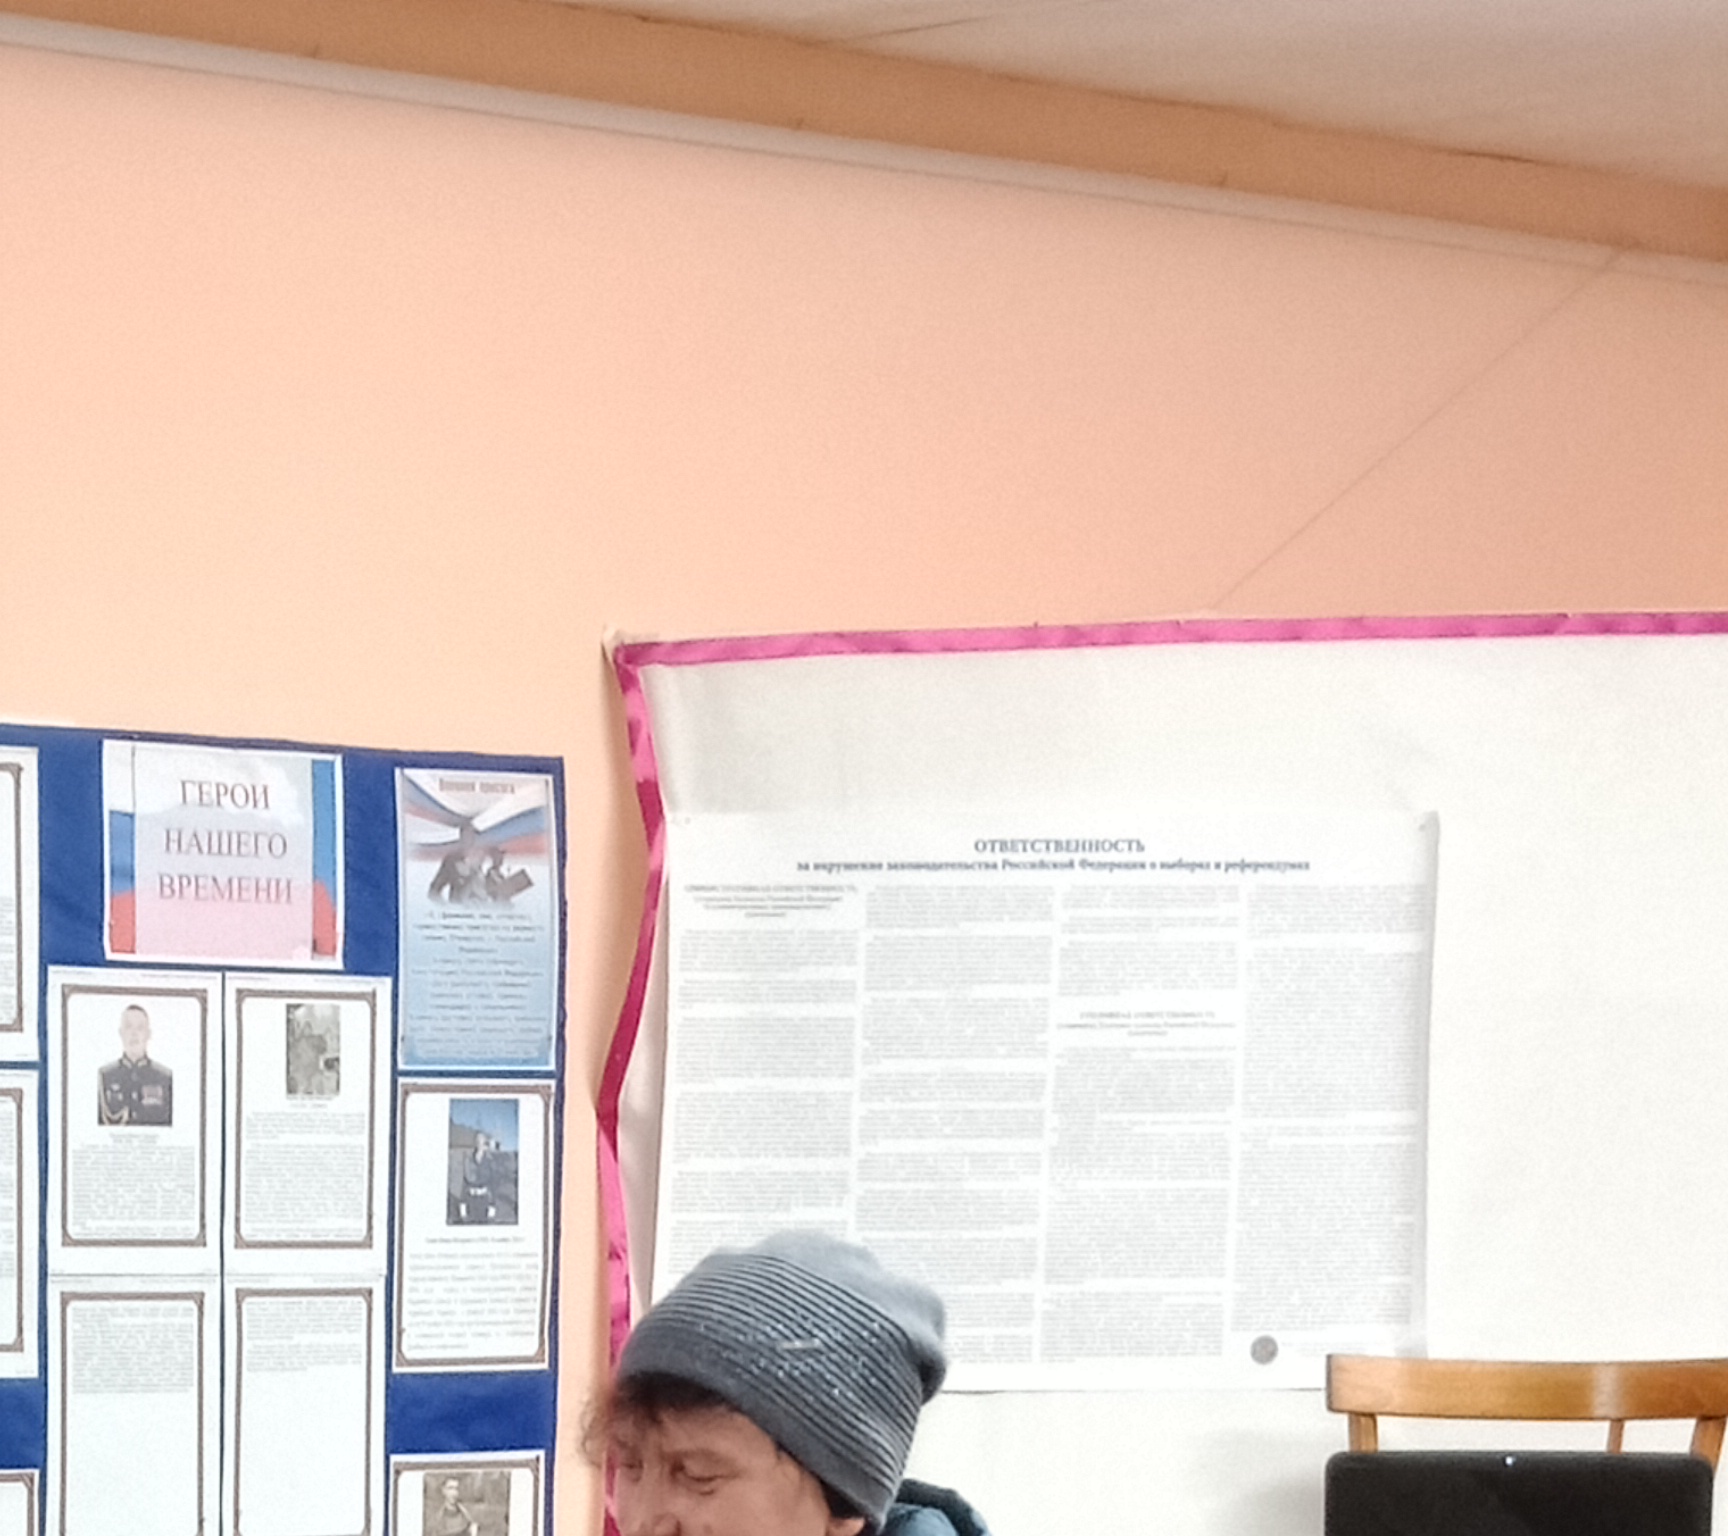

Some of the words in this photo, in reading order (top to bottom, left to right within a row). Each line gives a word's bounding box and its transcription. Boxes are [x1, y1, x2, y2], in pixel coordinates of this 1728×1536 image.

[180, 779, 270, 810] ГЕРОИ
[164, 827, 287, 860] НАШЕГО
[974, 838, 1145, 854] ОТВЕТСТВЕННОСТЬ
[1002, 858, 1075, 871] Российской
[1079, 858, 1146, 873] Федерации
[158, 871, 293, 905] ВРЕМЕНИ
